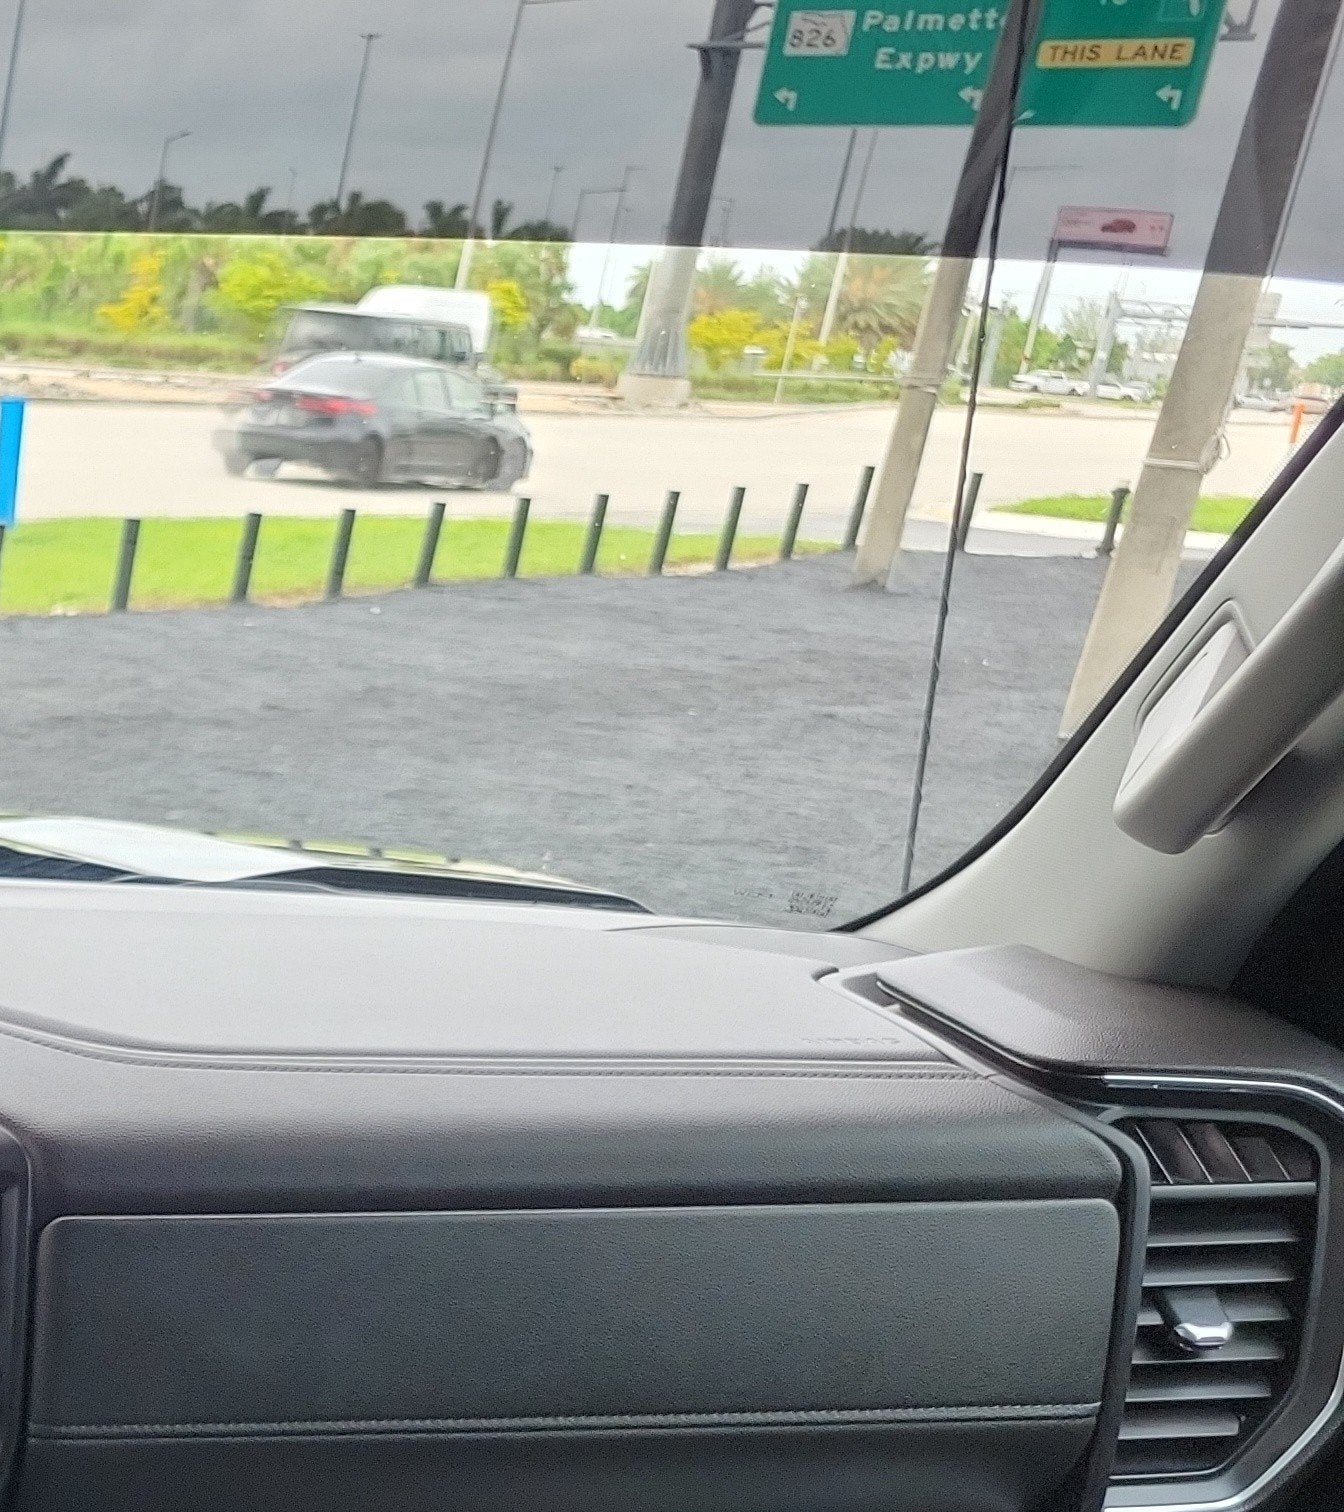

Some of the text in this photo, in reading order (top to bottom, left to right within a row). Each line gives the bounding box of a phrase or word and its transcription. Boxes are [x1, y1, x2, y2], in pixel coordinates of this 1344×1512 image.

[788, 29, 837, 48] 826
[874, 46, 982, 75] Expwy
[1049, 43, 1187, 62] THIS LANE
